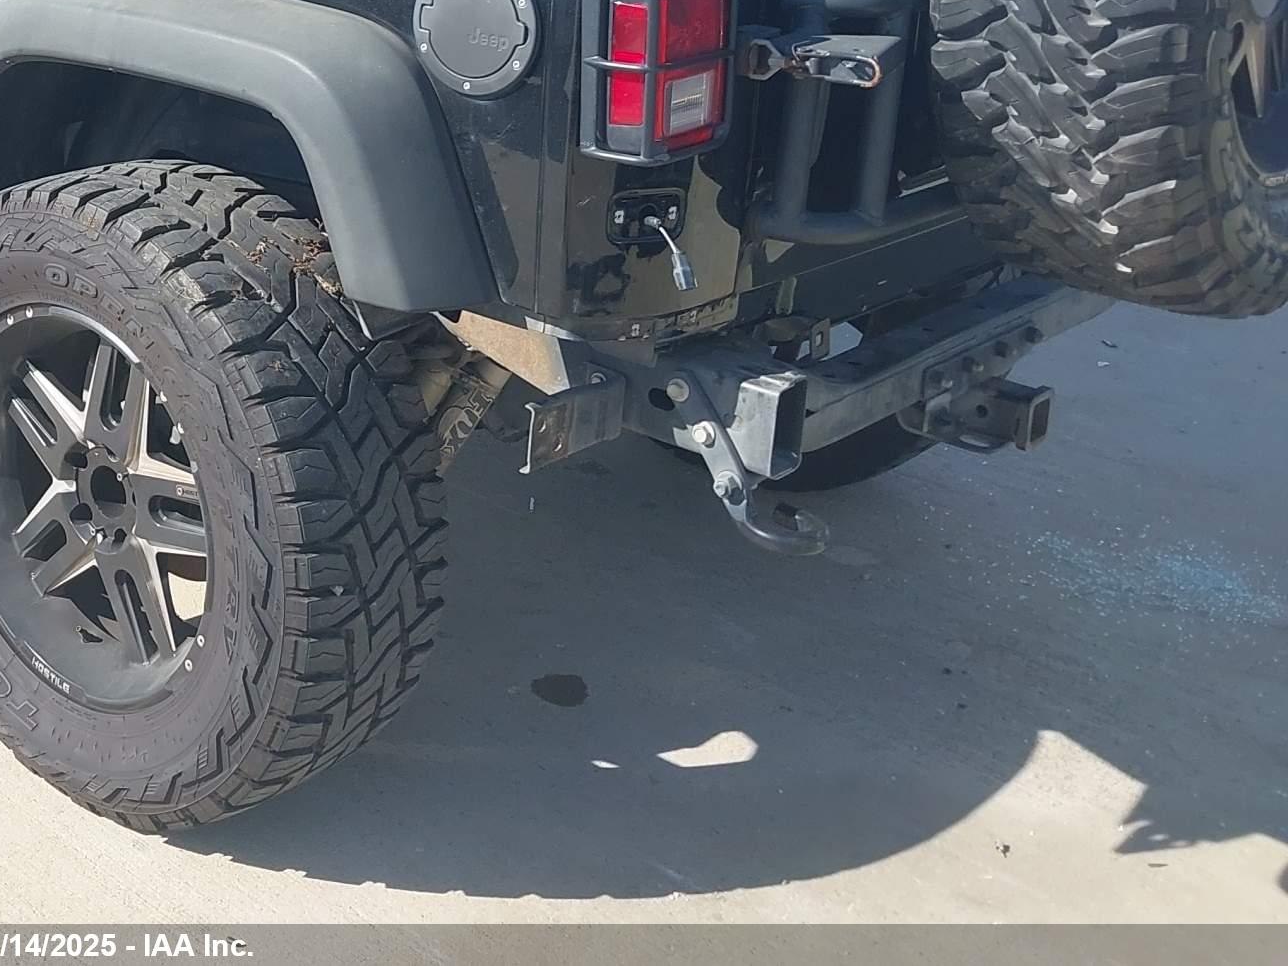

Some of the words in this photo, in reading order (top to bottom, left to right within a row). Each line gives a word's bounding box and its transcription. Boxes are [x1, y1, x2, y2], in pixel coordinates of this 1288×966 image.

[467, 27, 509, 52] Jeep
[44, 263, 154, 350] OPEN
[31, 656, 70, 694] HOSTILE
